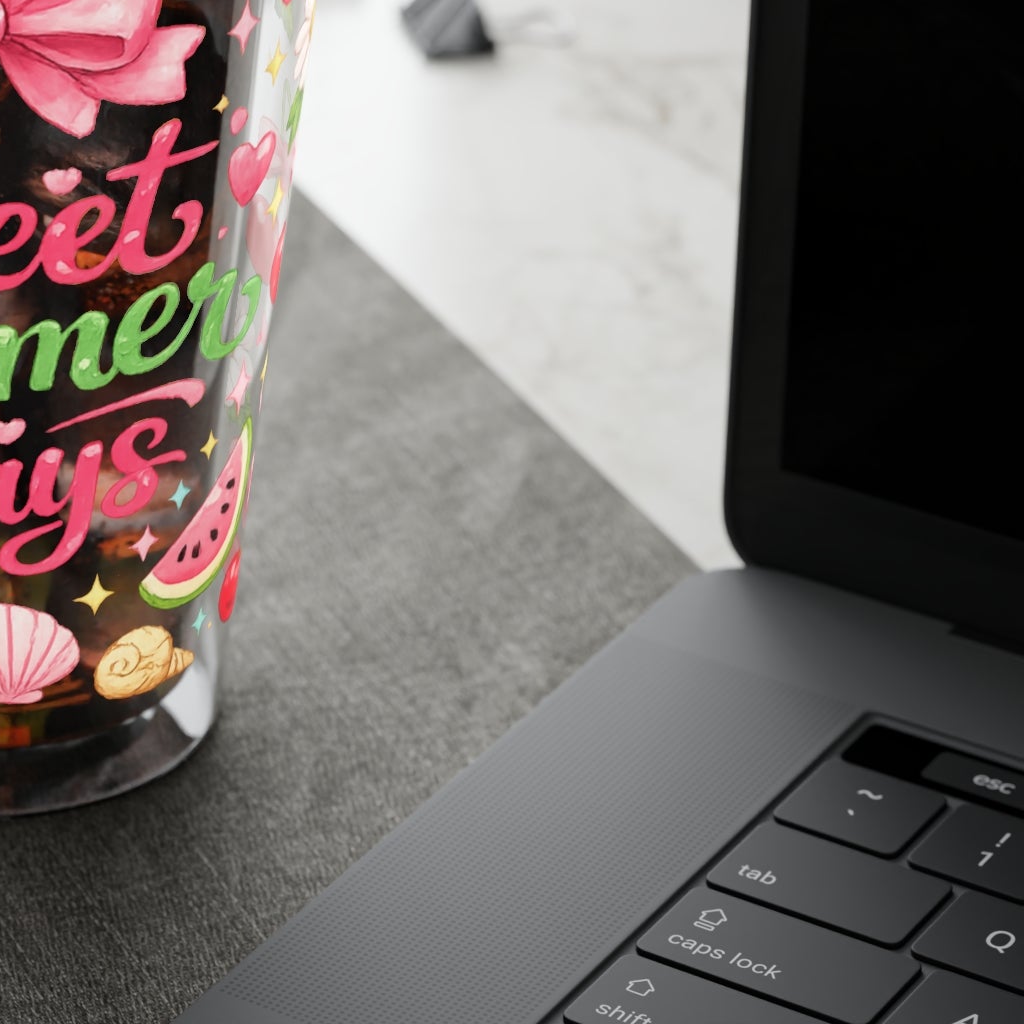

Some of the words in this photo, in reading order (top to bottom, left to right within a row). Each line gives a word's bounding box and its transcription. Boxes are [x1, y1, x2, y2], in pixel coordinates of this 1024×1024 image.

[972, 773, 1016, 795] esc
[995, 832, 1012, 848] !
[977, 850, 994, 867] 1
[737, 864, 777, 885] tab
[985, 929, 1017, 954] Q
[667, 933, 726, 960] caps
[728, 951, 783, 980] lock
[595, 1003, 653, 1024] shift
